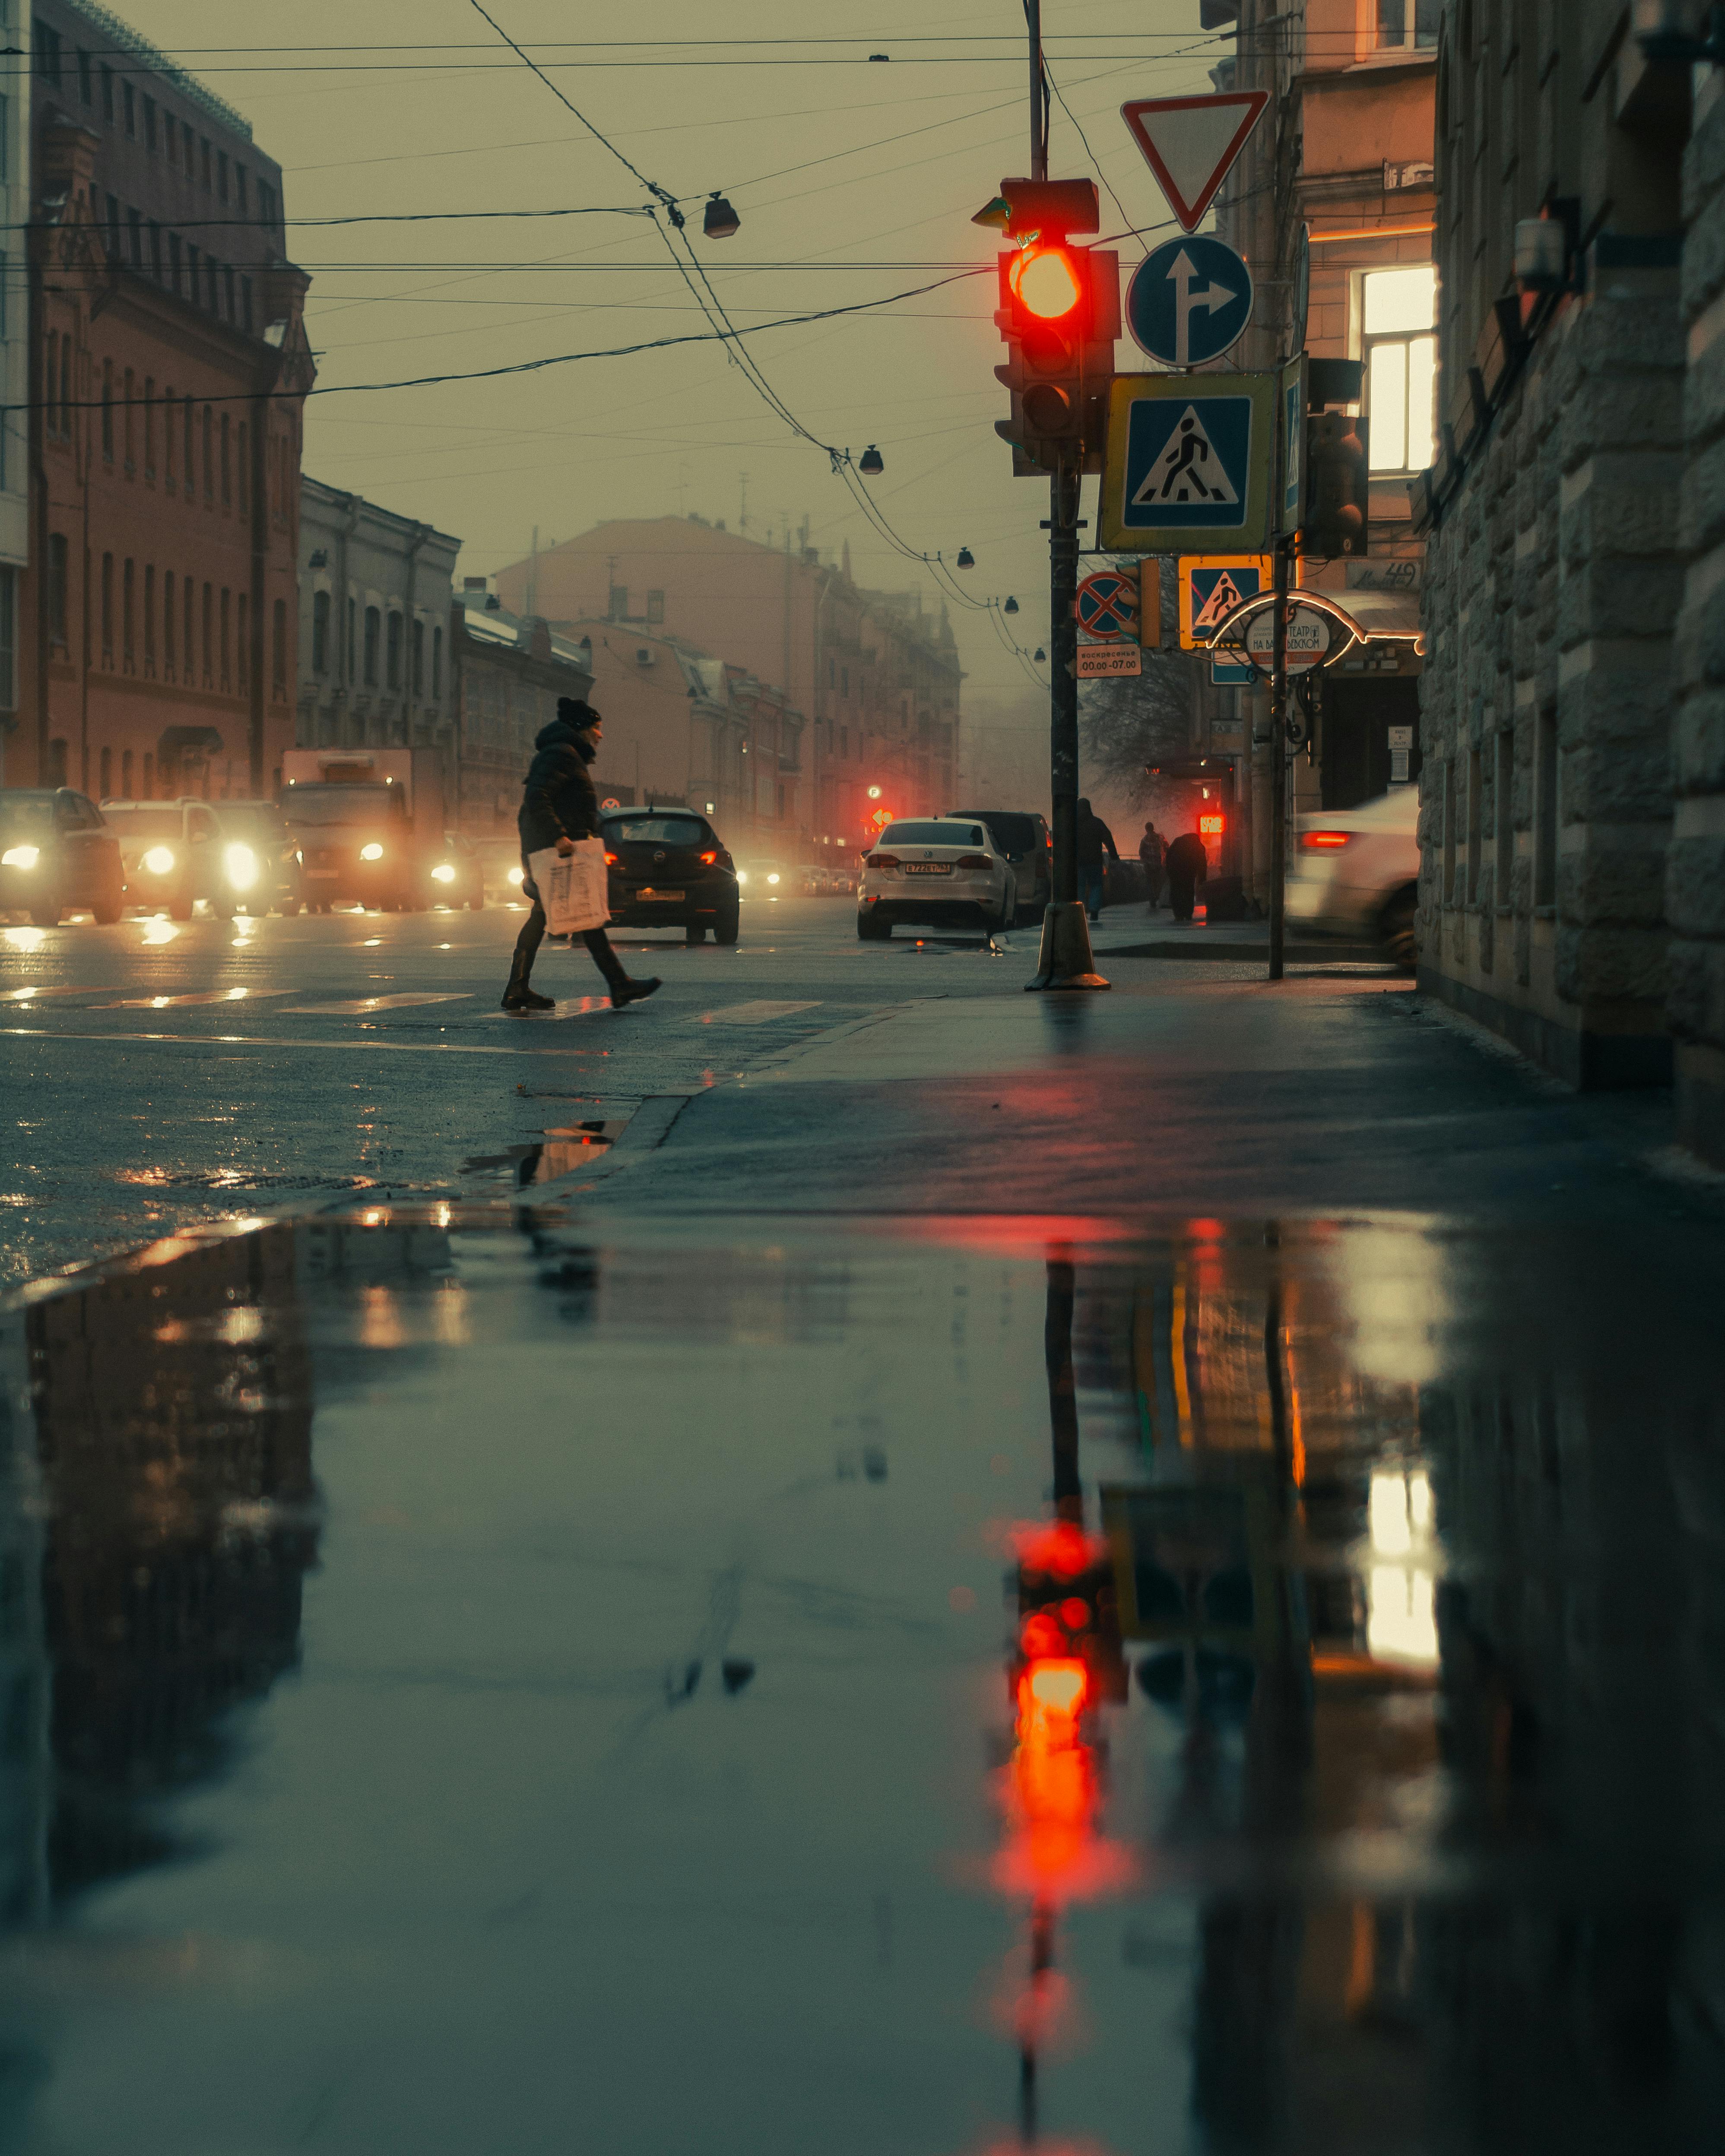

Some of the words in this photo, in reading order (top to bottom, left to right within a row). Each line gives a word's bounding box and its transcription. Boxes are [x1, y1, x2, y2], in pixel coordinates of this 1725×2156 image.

[1289, 626, 1310, 637] ТЕАТР
[1253, 640, 1263, 650] НА
[1266, 639, 1319, 649] ВАЬЕВСКОМ
[1081, 651, 1135, 659] воскресенье
